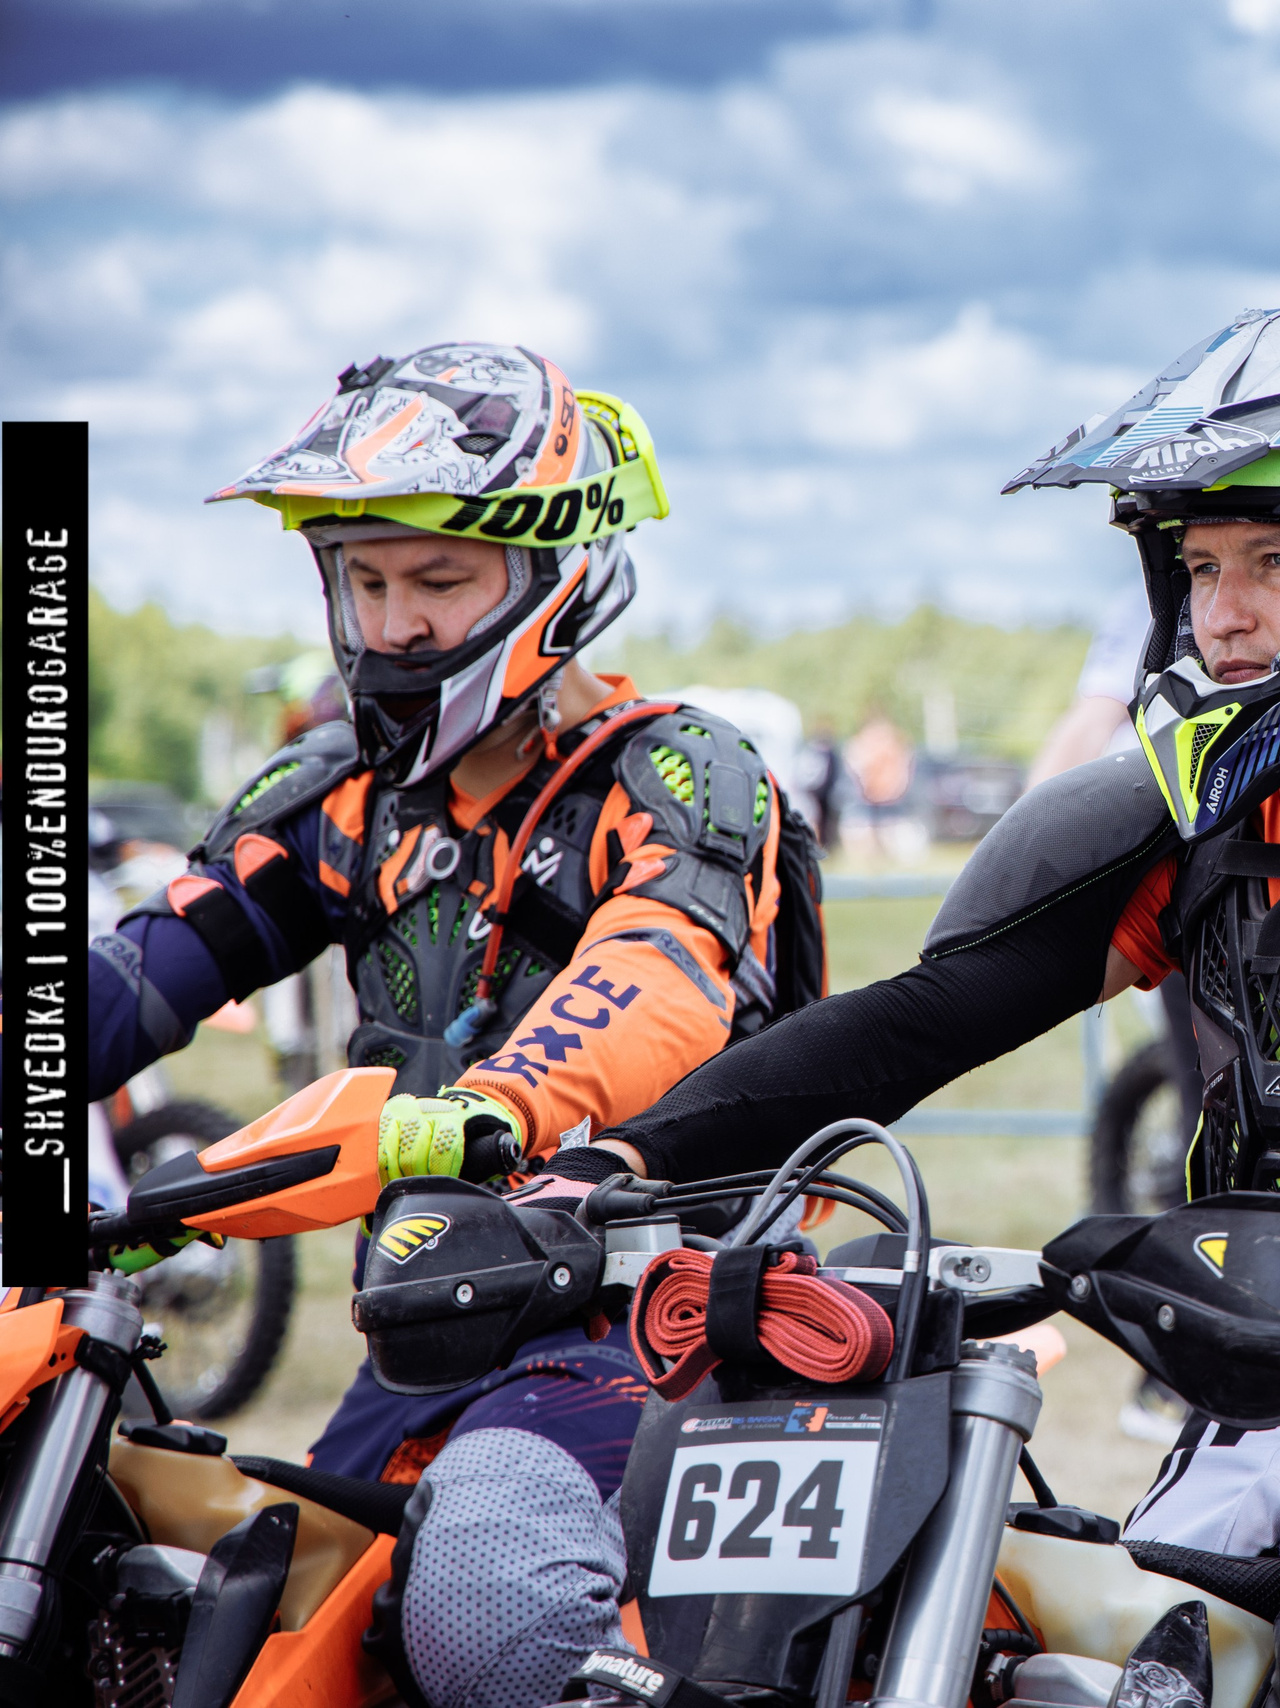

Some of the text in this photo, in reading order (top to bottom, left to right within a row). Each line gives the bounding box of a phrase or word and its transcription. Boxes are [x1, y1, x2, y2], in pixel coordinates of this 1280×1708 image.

[440, 476, 625, 543] 100%
[1206, 767, 1229, 815] AIROH
[667, 1459, 844, 1562] 624
